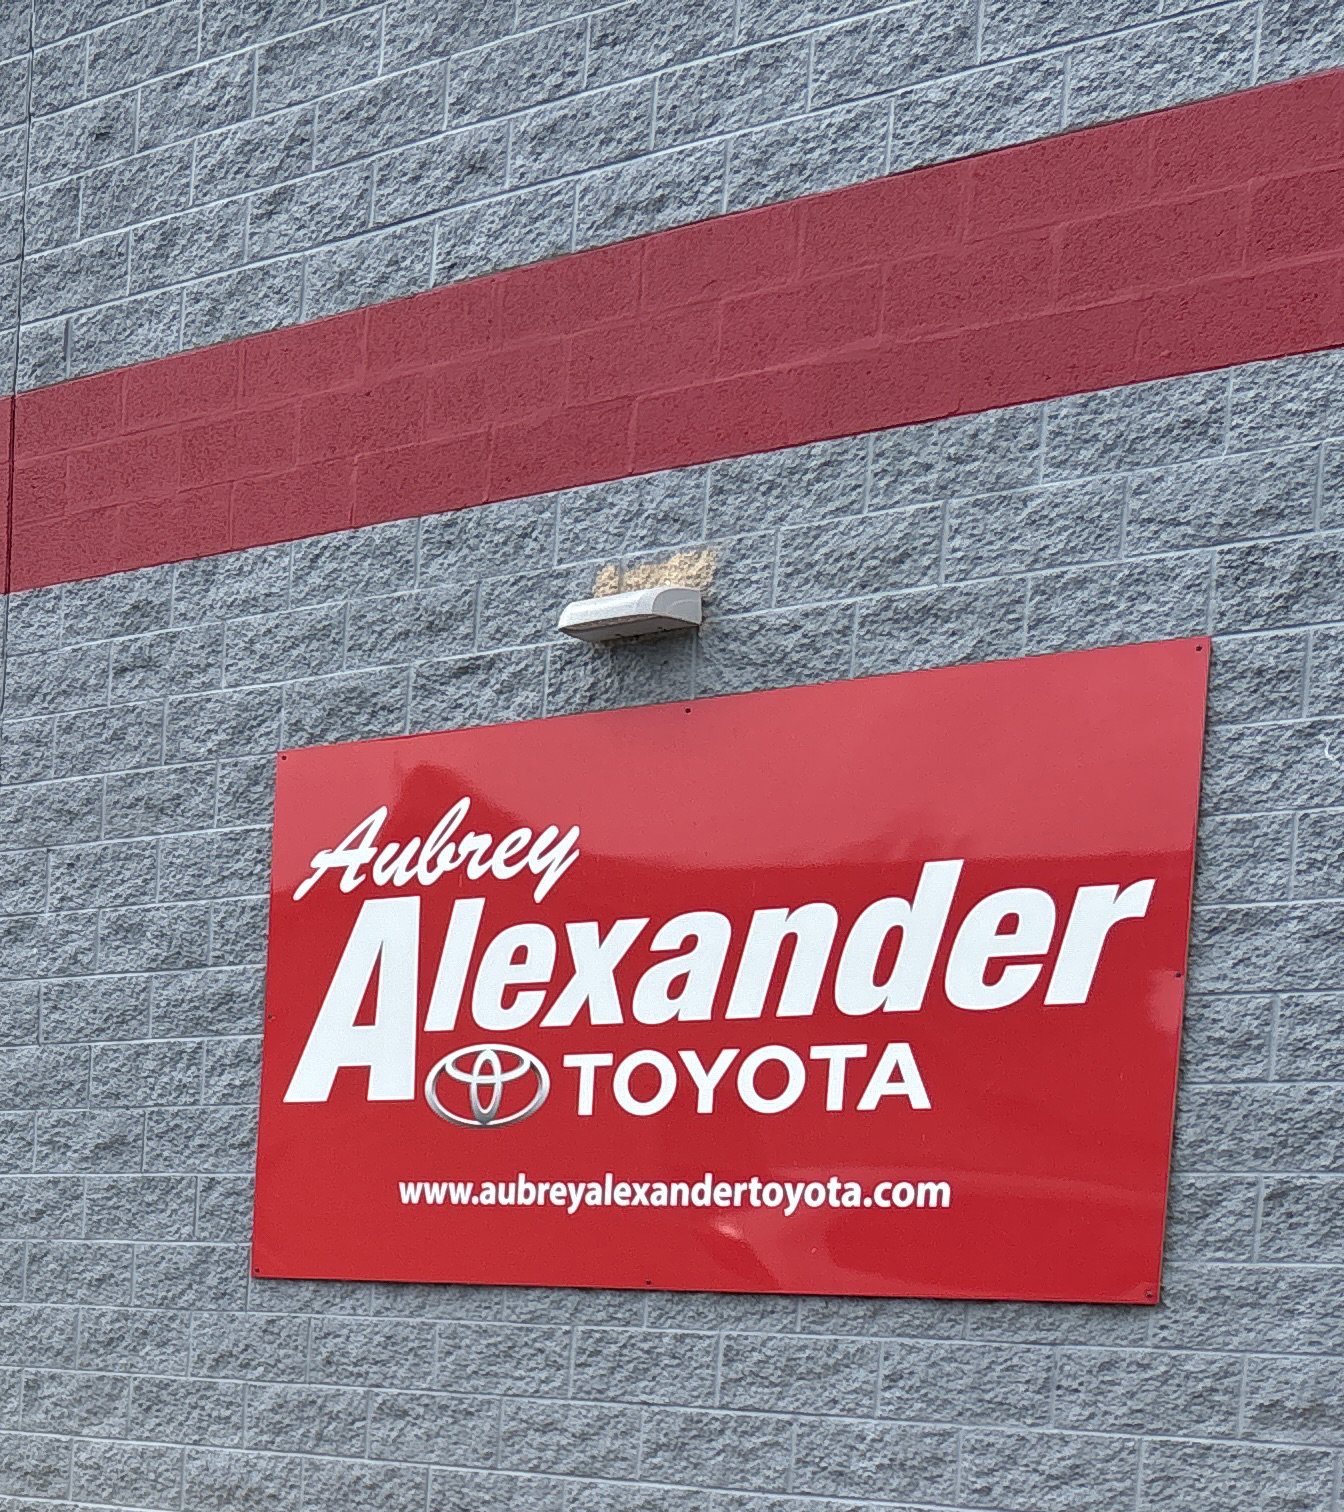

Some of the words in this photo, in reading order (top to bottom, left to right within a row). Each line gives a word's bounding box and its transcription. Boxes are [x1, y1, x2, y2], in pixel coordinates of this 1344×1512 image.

[292, 796, 581, 904] Aubrey
[282, 858, 1156, 1103] Alexander
[563, 1042, 932, 1116] TOYOTA
[398, 1172, 951, 1217] www.aubreyalexandertoyota.com
